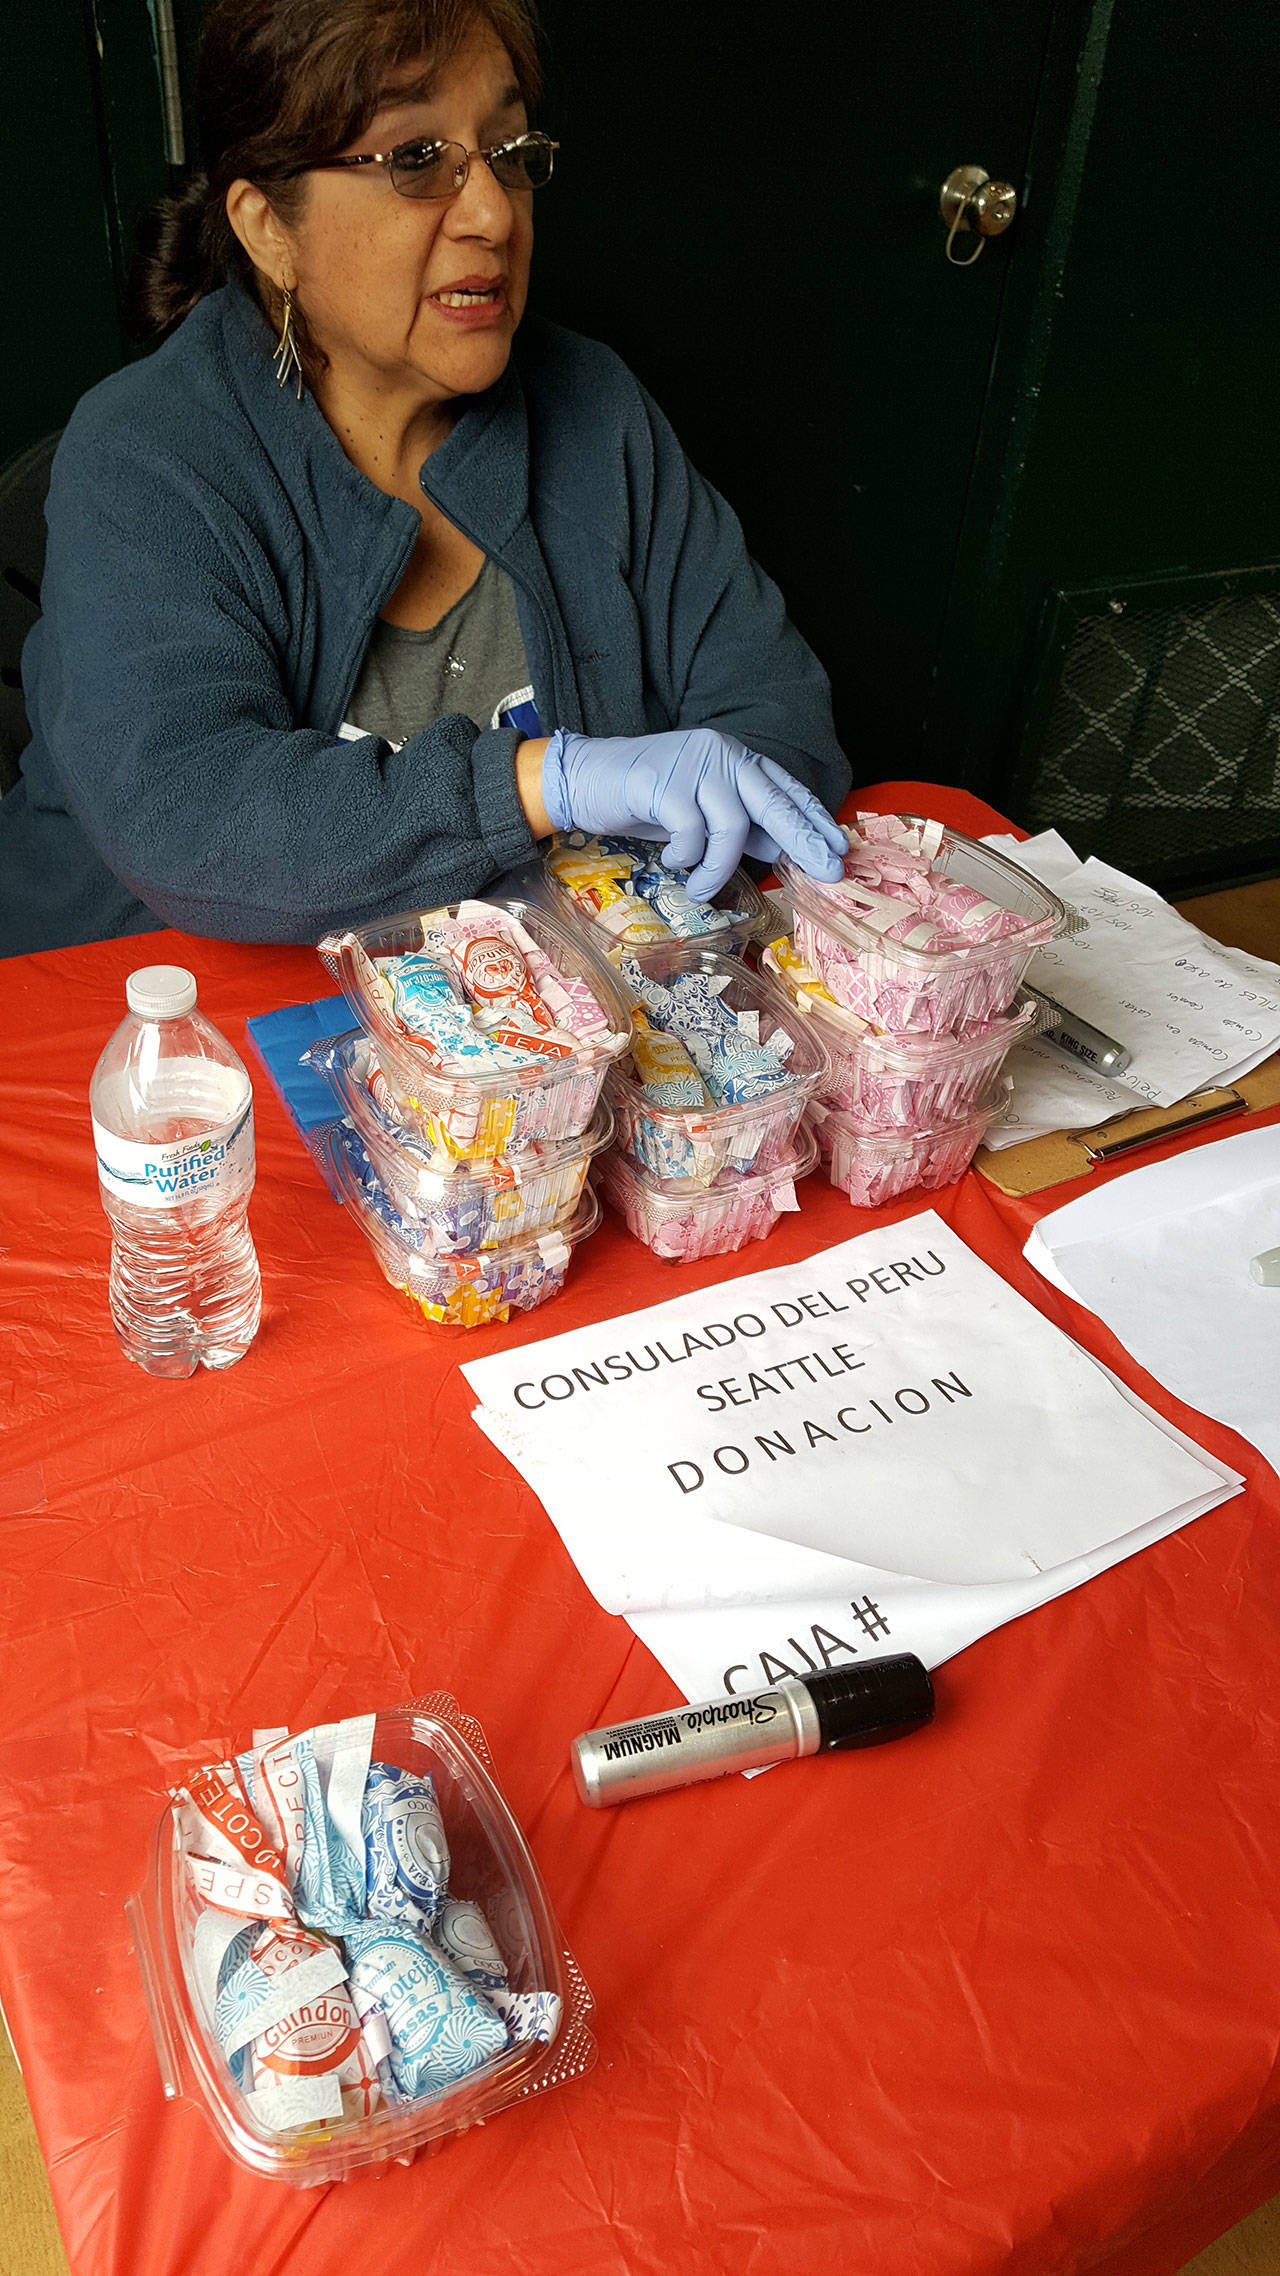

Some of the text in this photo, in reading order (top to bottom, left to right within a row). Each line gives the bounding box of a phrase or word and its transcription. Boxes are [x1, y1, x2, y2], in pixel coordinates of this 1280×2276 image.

[145, 1145, 225, 1178] Purified
[155, 1166, 219, 1193] Water
[513, 1250, 947, 1410] CONSULADO DEL PERU
[697, 1343, 866, 1412] SEATTLE
[667, 1371, 975, 1495] DONACION
